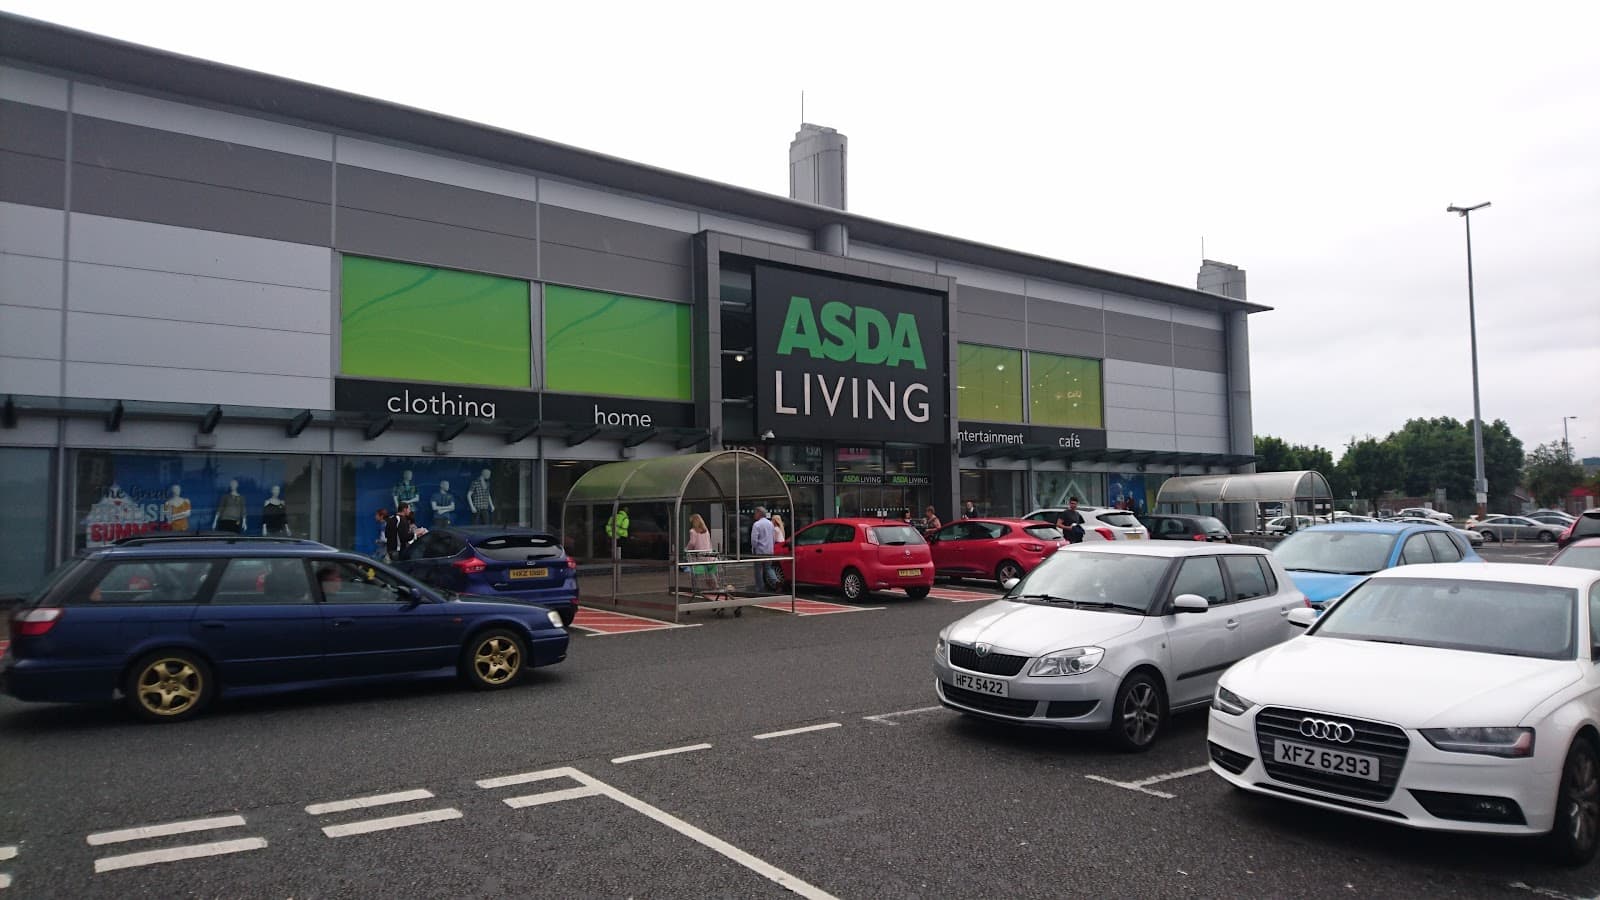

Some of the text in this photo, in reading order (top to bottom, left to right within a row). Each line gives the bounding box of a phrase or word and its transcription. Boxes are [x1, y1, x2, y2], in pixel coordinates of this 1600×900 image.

[776, 296, 927, 370] ASDA
[387, 389, 496, 420] clothing
[775, 370, 930, 423] LIVING
[594, 404, 652, 427] home
[957, 429, 1023, 445] ntertainment
[1058, 432, 1081, 448] café
[796, 474, 820, 483] LIVING
[842, 474, 882, 484] ASDA LIVING
[892, 475, 929, 484] ASDA LIVING
[955, 672, 1003, 695] HFZ 5422
[1281, 743, 1370, 776] XFZ 6293
